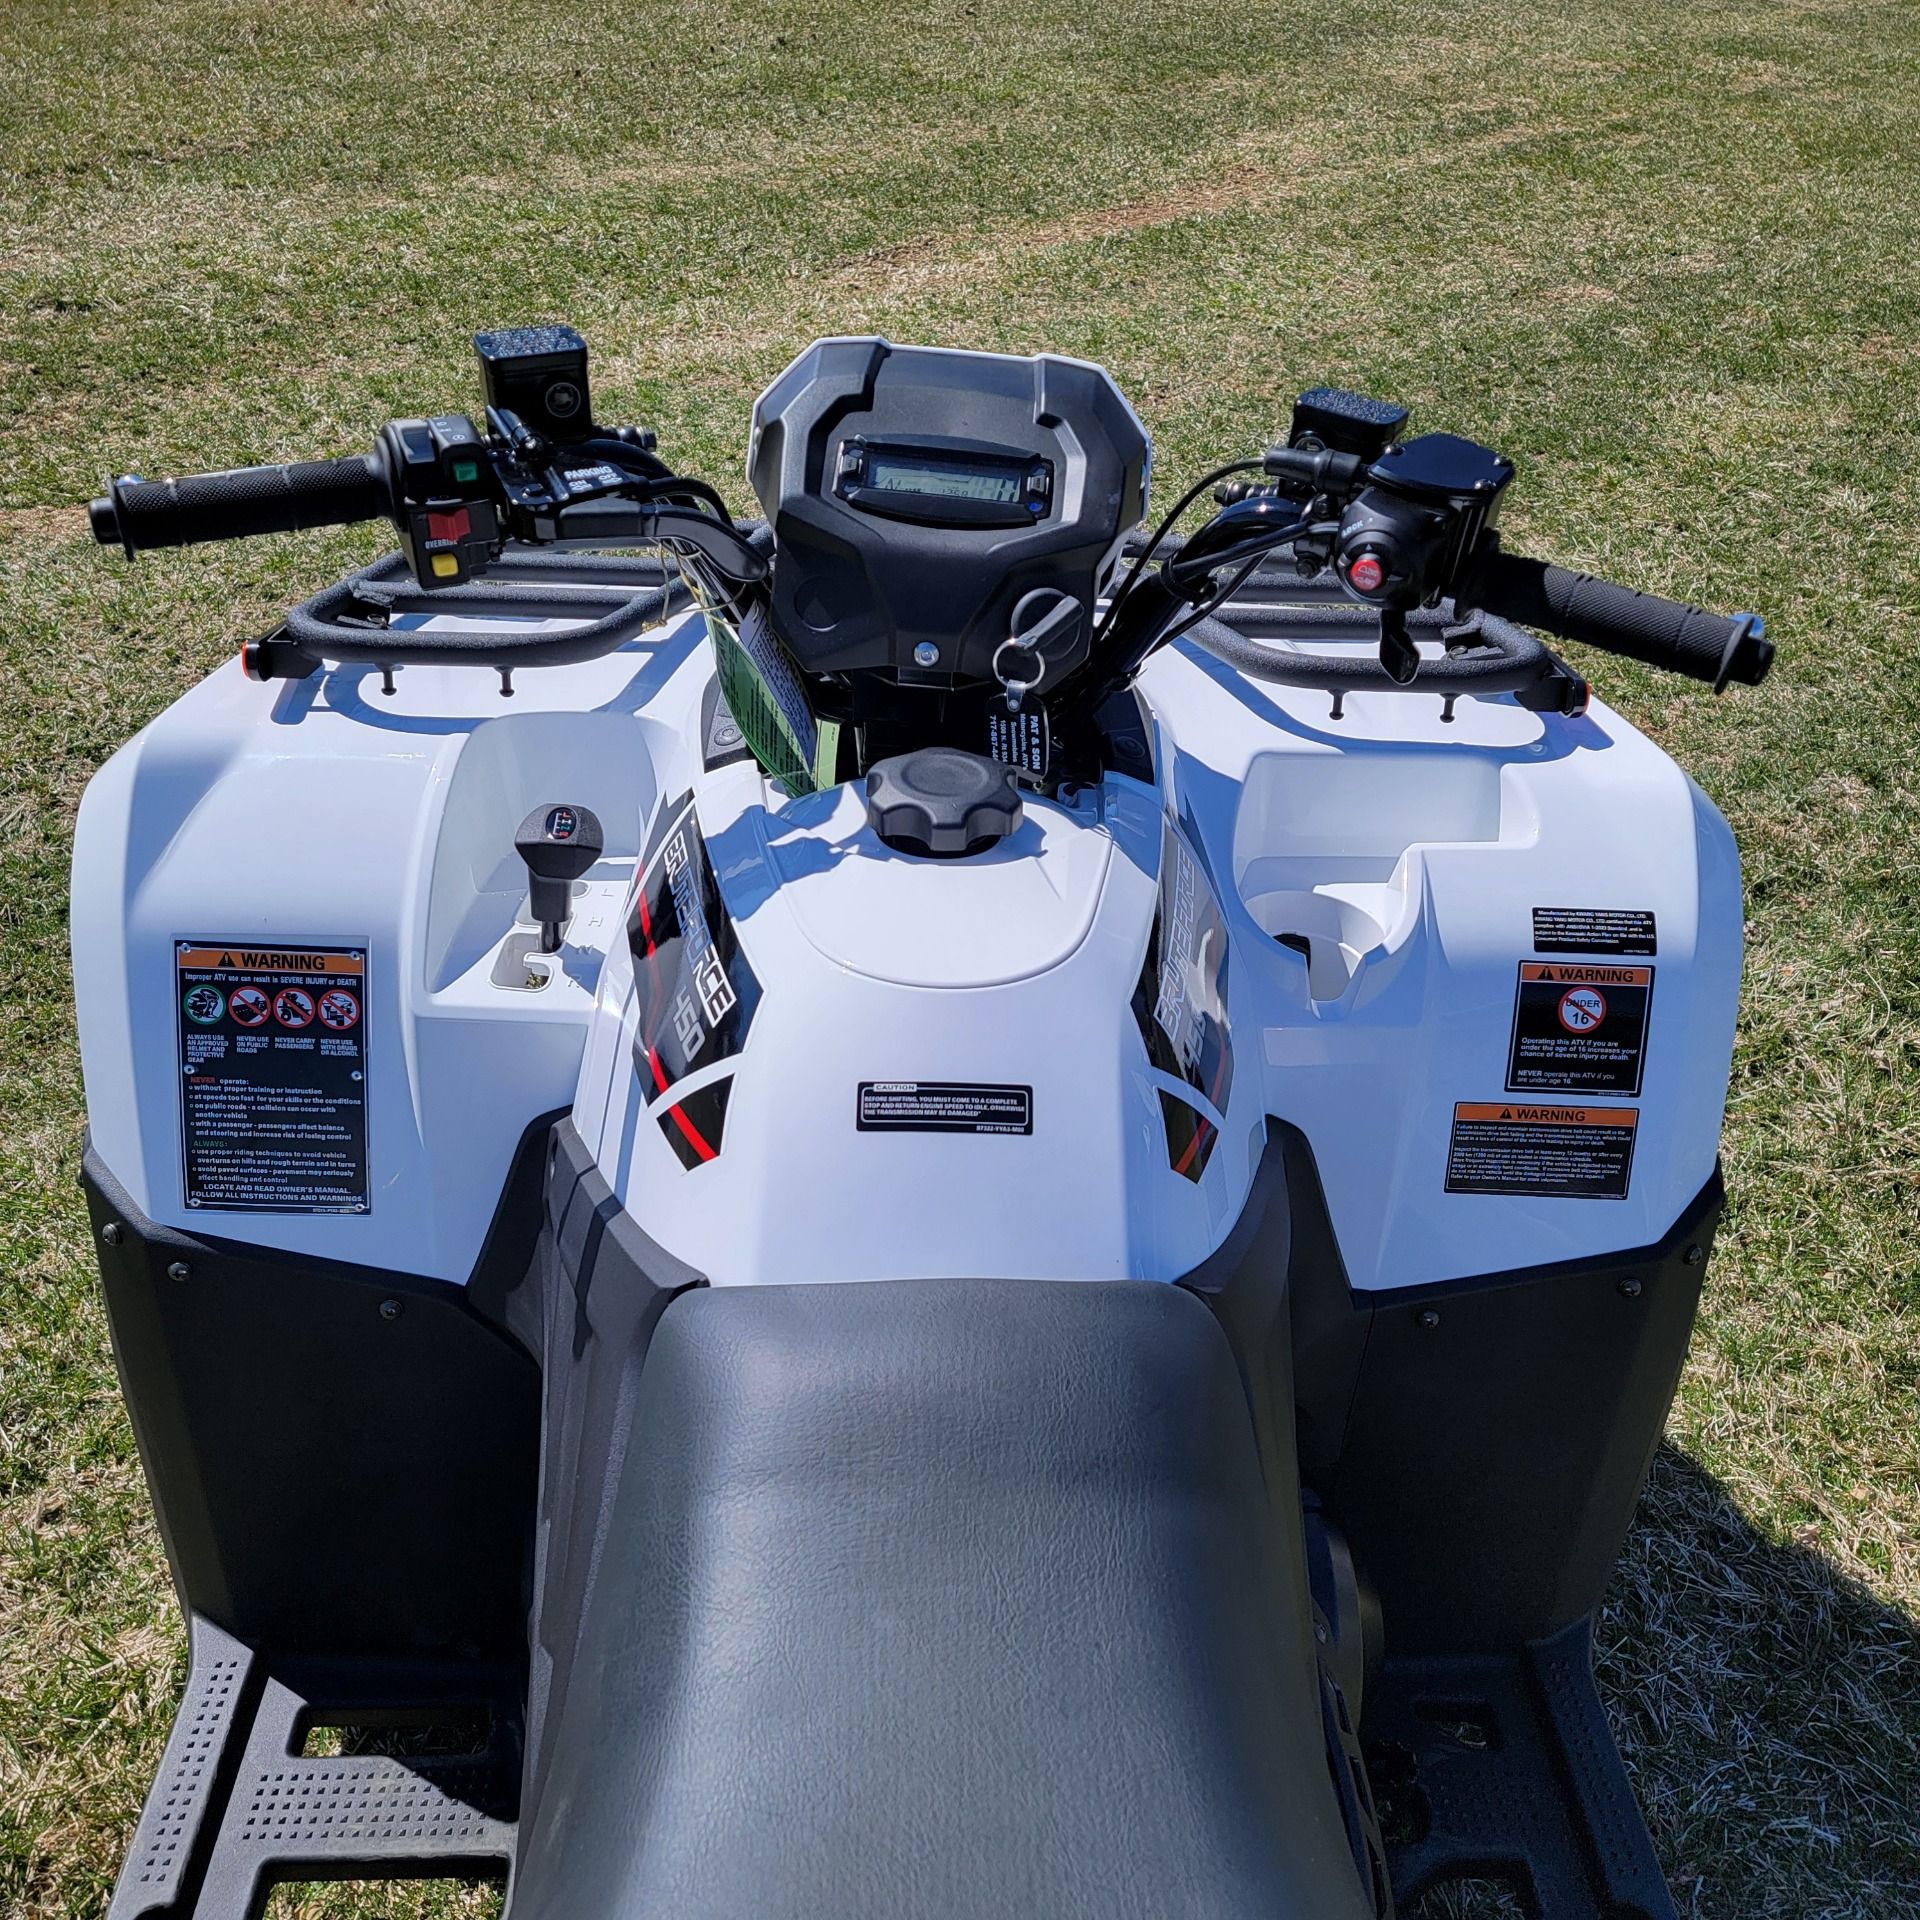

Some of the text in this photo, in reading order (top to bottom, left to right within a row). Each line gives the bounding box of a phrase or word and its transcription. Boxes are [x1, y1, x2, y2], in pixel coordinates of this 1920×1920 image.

[564, 466, 614, 480] PARKING
[598, 472, 618, 480] OFF
[1341, 520, 1363, 538] LOCK
[1010, 721, 1018, 762] Snowmobiles
[1030, 716, 1040, 770] PAT & SON
[240, 952, 325, 970] WARNING
[185, 972, 212, 982] Improper
[214, 973, 226, 981] ATV
[280, 976, 303, 984] SEVERE
[1560, 968, 1634, 982] WARNING
[1566, 1000, 1600, 1008] UNDER
[672, 985, 706, 1063] 450
[1572, 1012, 1589, 1025] 16
[1522, 1037, 1555, 1046] Operating
[248, 1086, 275, 1094] training
[1517, 1109, 1585, 1121] WARNING
[240, 1192, 298, 1200] INSTRUCTIONS
